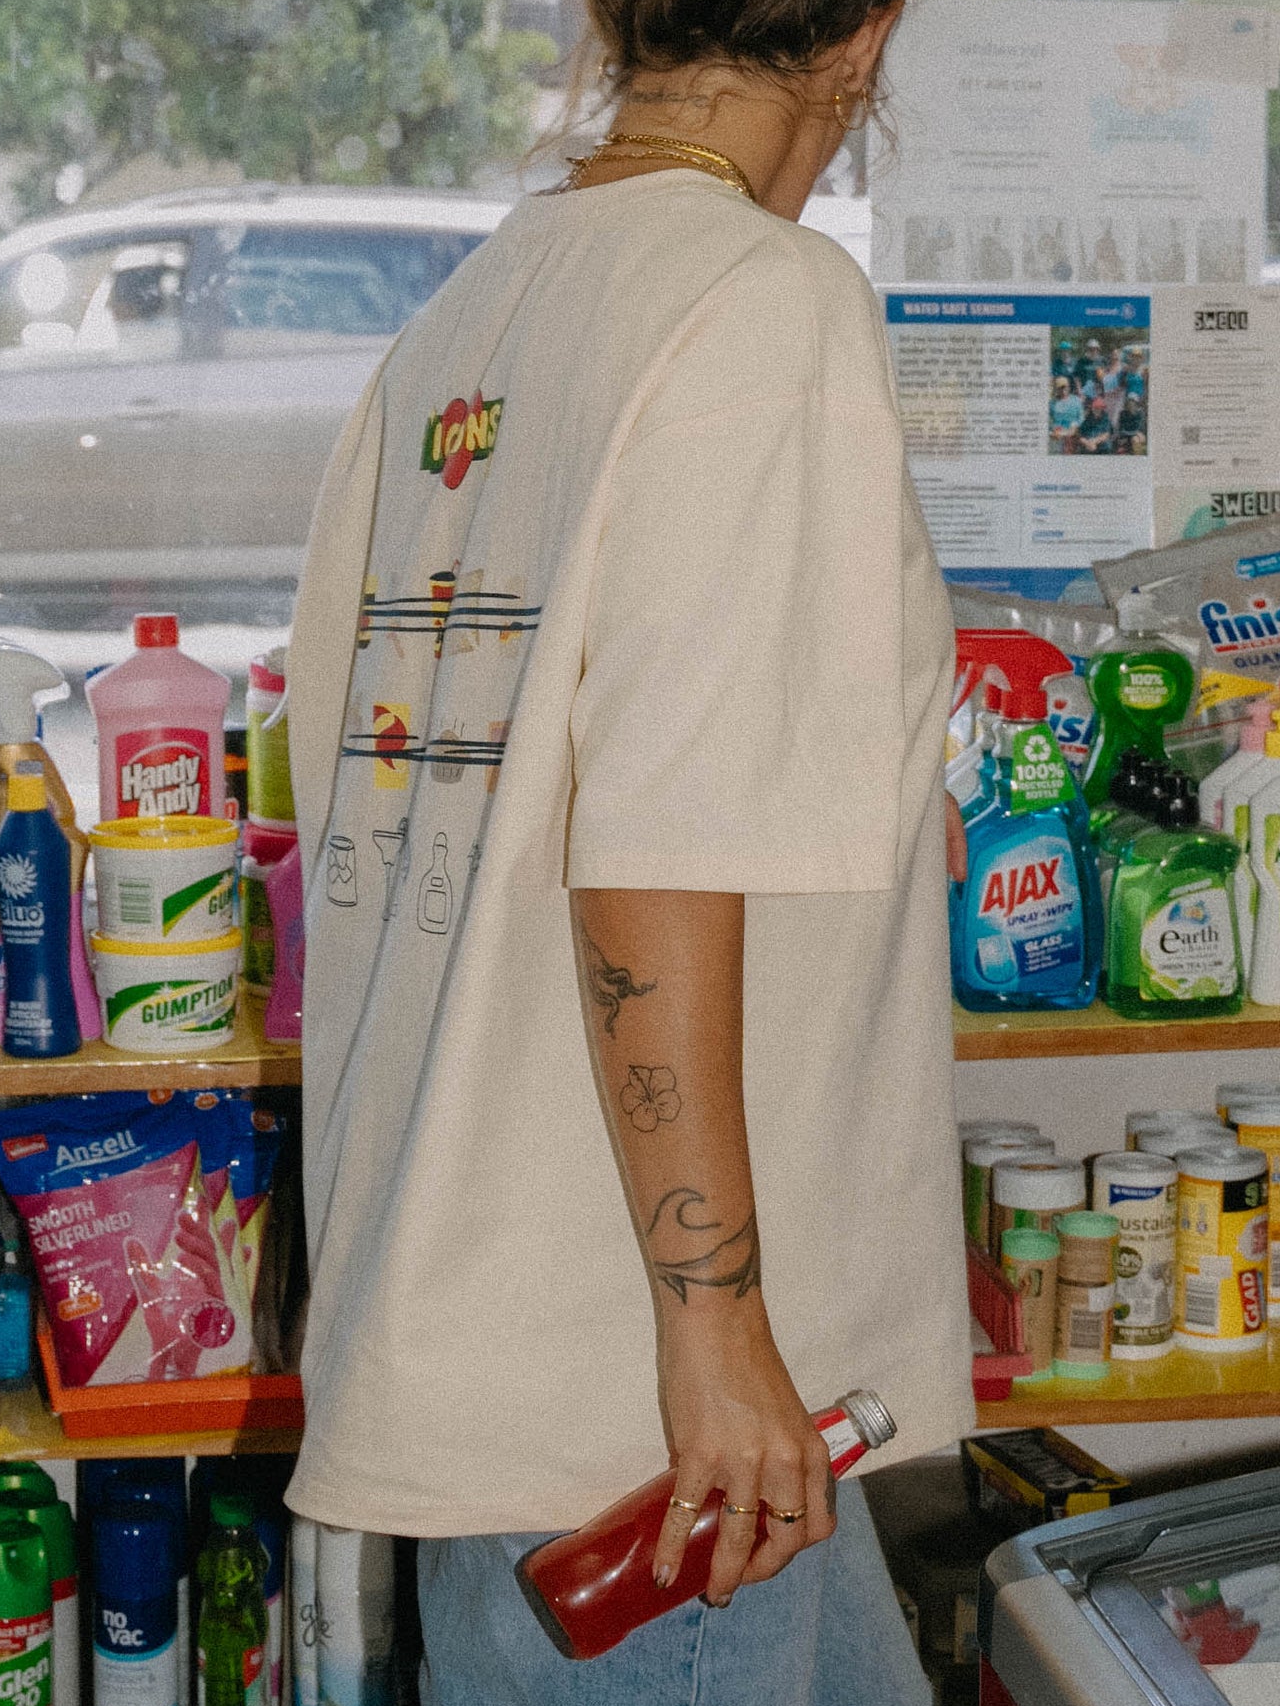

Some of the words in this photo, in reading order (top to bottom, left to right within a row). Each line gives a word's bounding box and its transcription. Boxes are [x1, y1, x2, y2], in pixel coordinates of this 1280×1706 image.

[1193, 310, 1249, 331] SWELL
[1128, 672, 1165, 689] 100%
[122, 754, 200, 802] Handy
[1016, 762, 1065, 784] 100%
[138, 782, 201, 819] Andy
[980, 858, 1059, 918] AJAX
[1006, 908, 1039, 929] SPRAY
[1023, 933, 1063, 951] GLASS
[1159, 923, 1220, 956] earth
[55, 1130, 136, 1167] Ansell
[27, 1199, 98, 1237] SMOOTH
[33, 1209, 134, 1252] SILVERLINED
[1243, 1272, 1262, 1330] GLAD
[102, 1609, 129, 1629] no
[106, 1625, 145, 1647] vac
